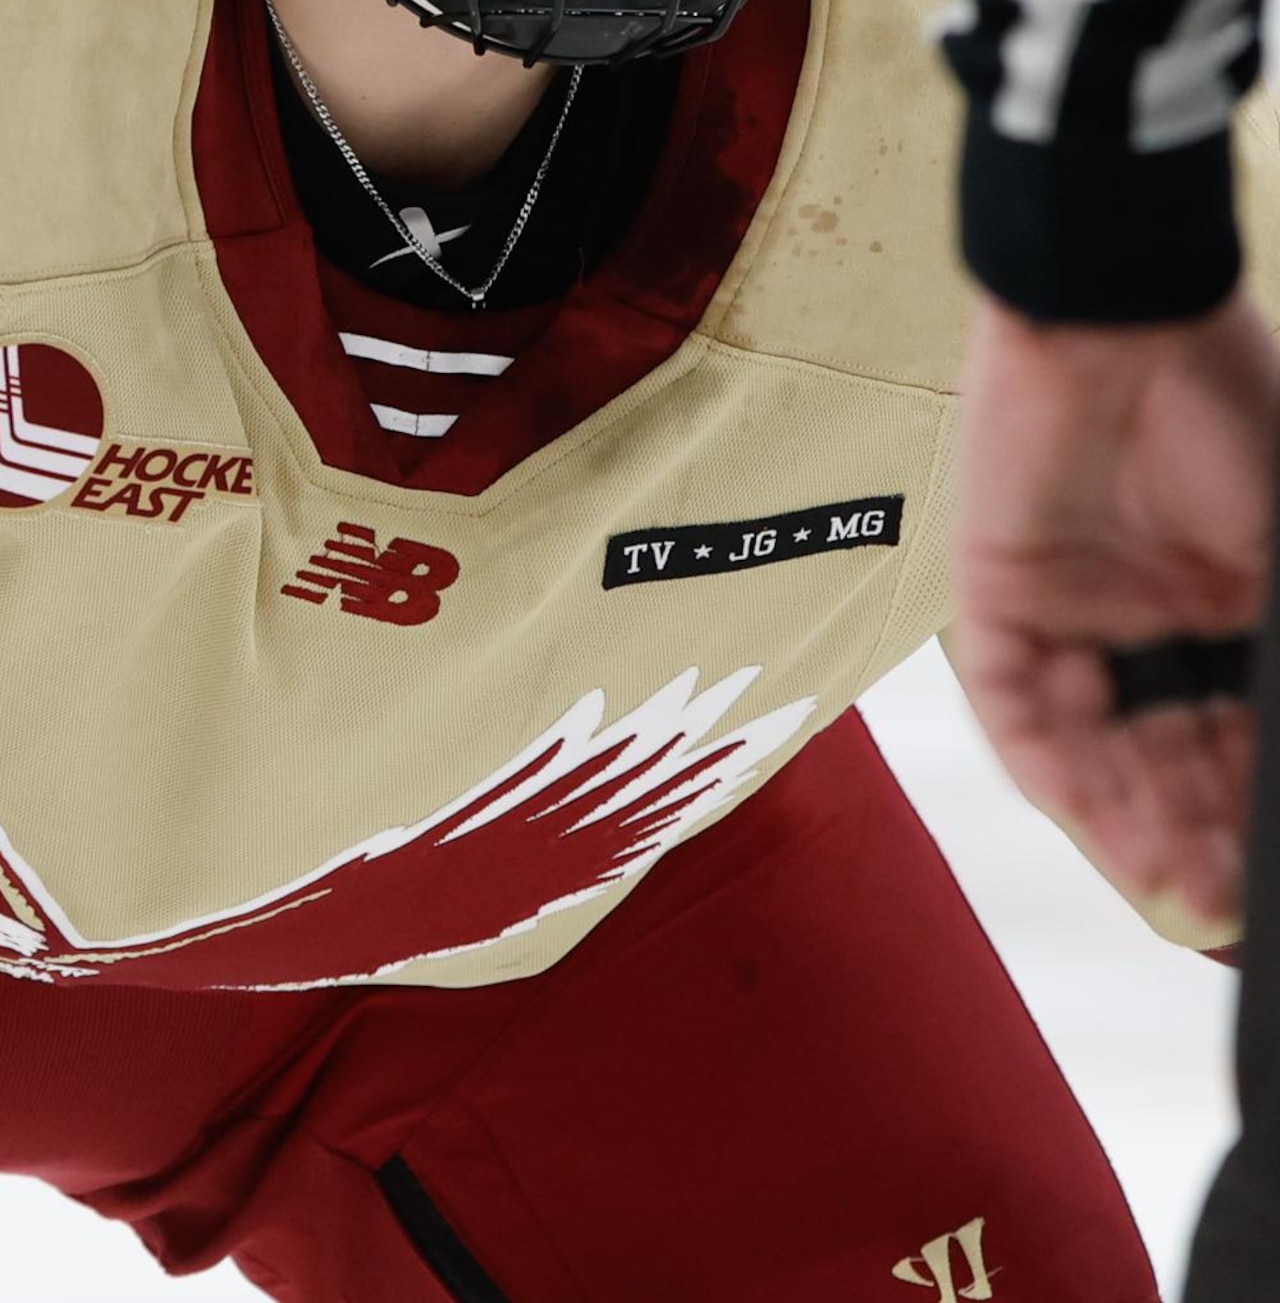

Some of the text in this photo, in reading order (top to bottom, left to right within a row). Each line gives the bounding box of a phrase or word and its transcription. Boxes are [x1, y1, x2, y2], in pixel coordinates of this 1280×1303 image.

[70, 477, 206, 523] EAST
[623, 510, 886, 574] TV JG MG
